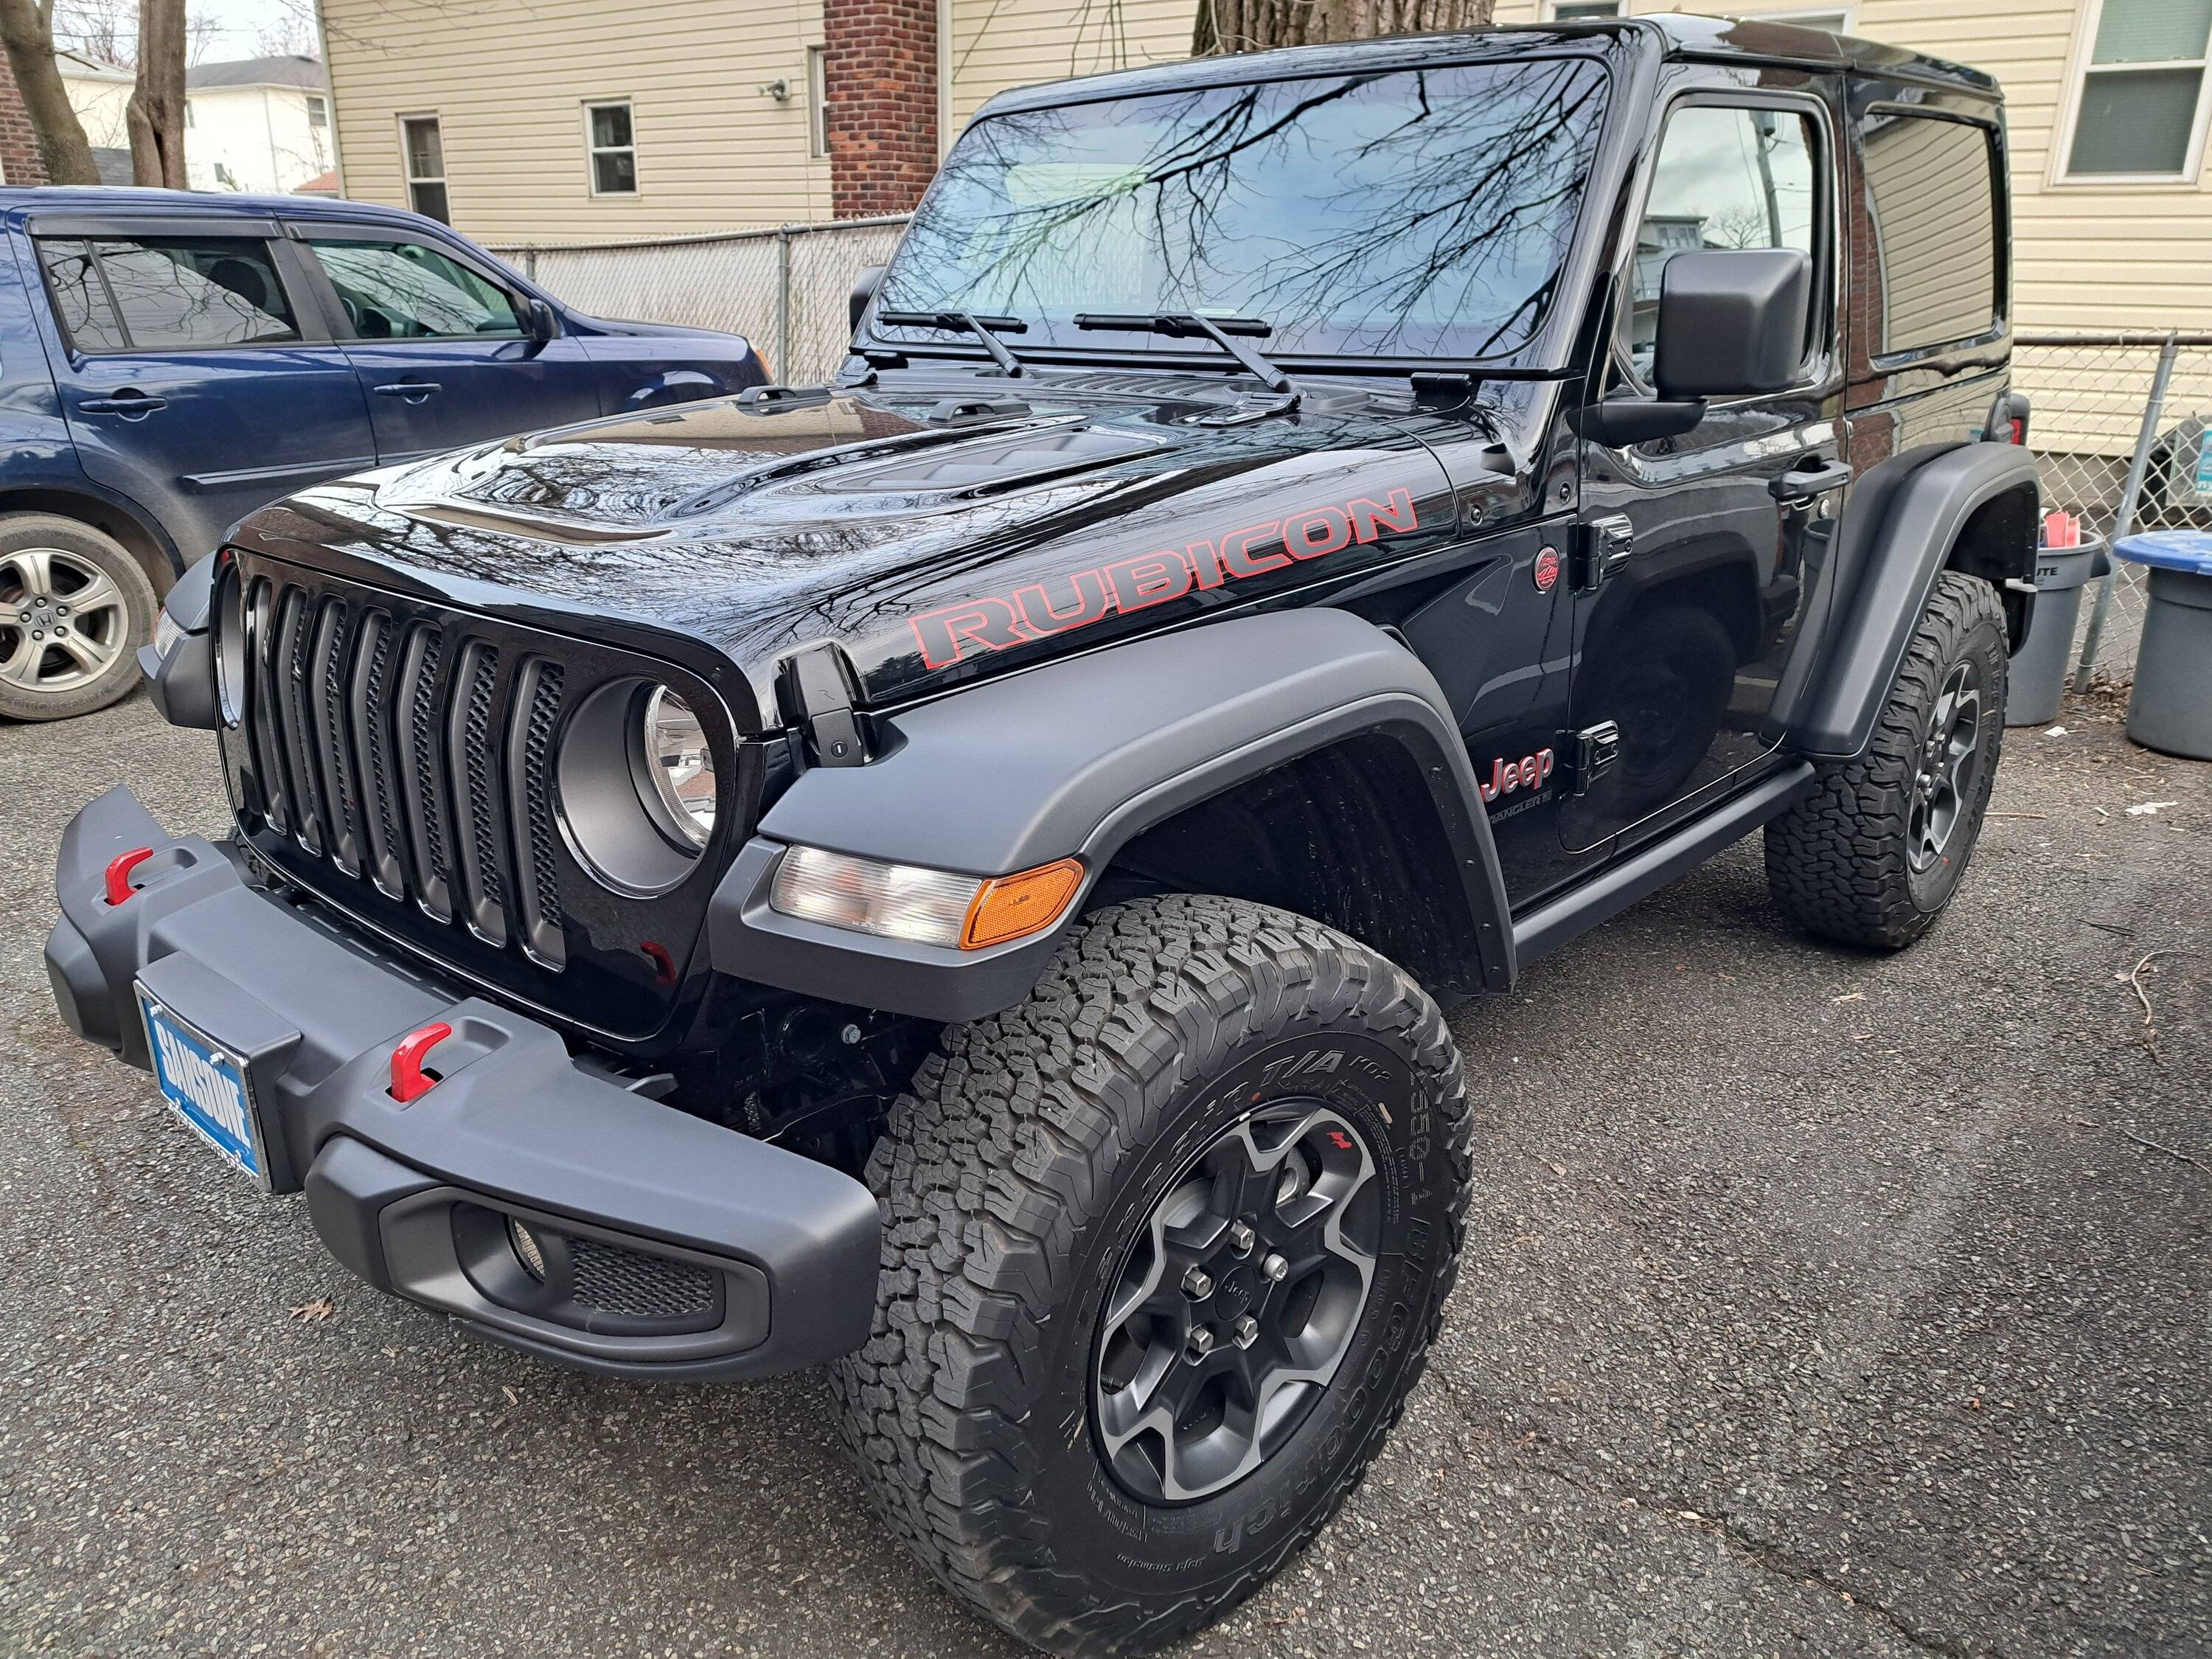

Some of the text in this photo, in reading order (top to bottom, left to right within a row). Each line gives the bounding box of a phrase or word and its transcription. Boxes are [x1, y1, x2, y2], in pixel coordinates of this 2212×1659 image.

[908, 487, 1419, 669] RUBICON
[1480, 748, 1554, 802] Jeep
[1489, 795, 1541, 824] RANGLER
[154, 1020, 251, 1149] SANSONE
[1259, 1050, 1345, 1088] T/A
[1225, 1281, 1249, 1304] Jeep
